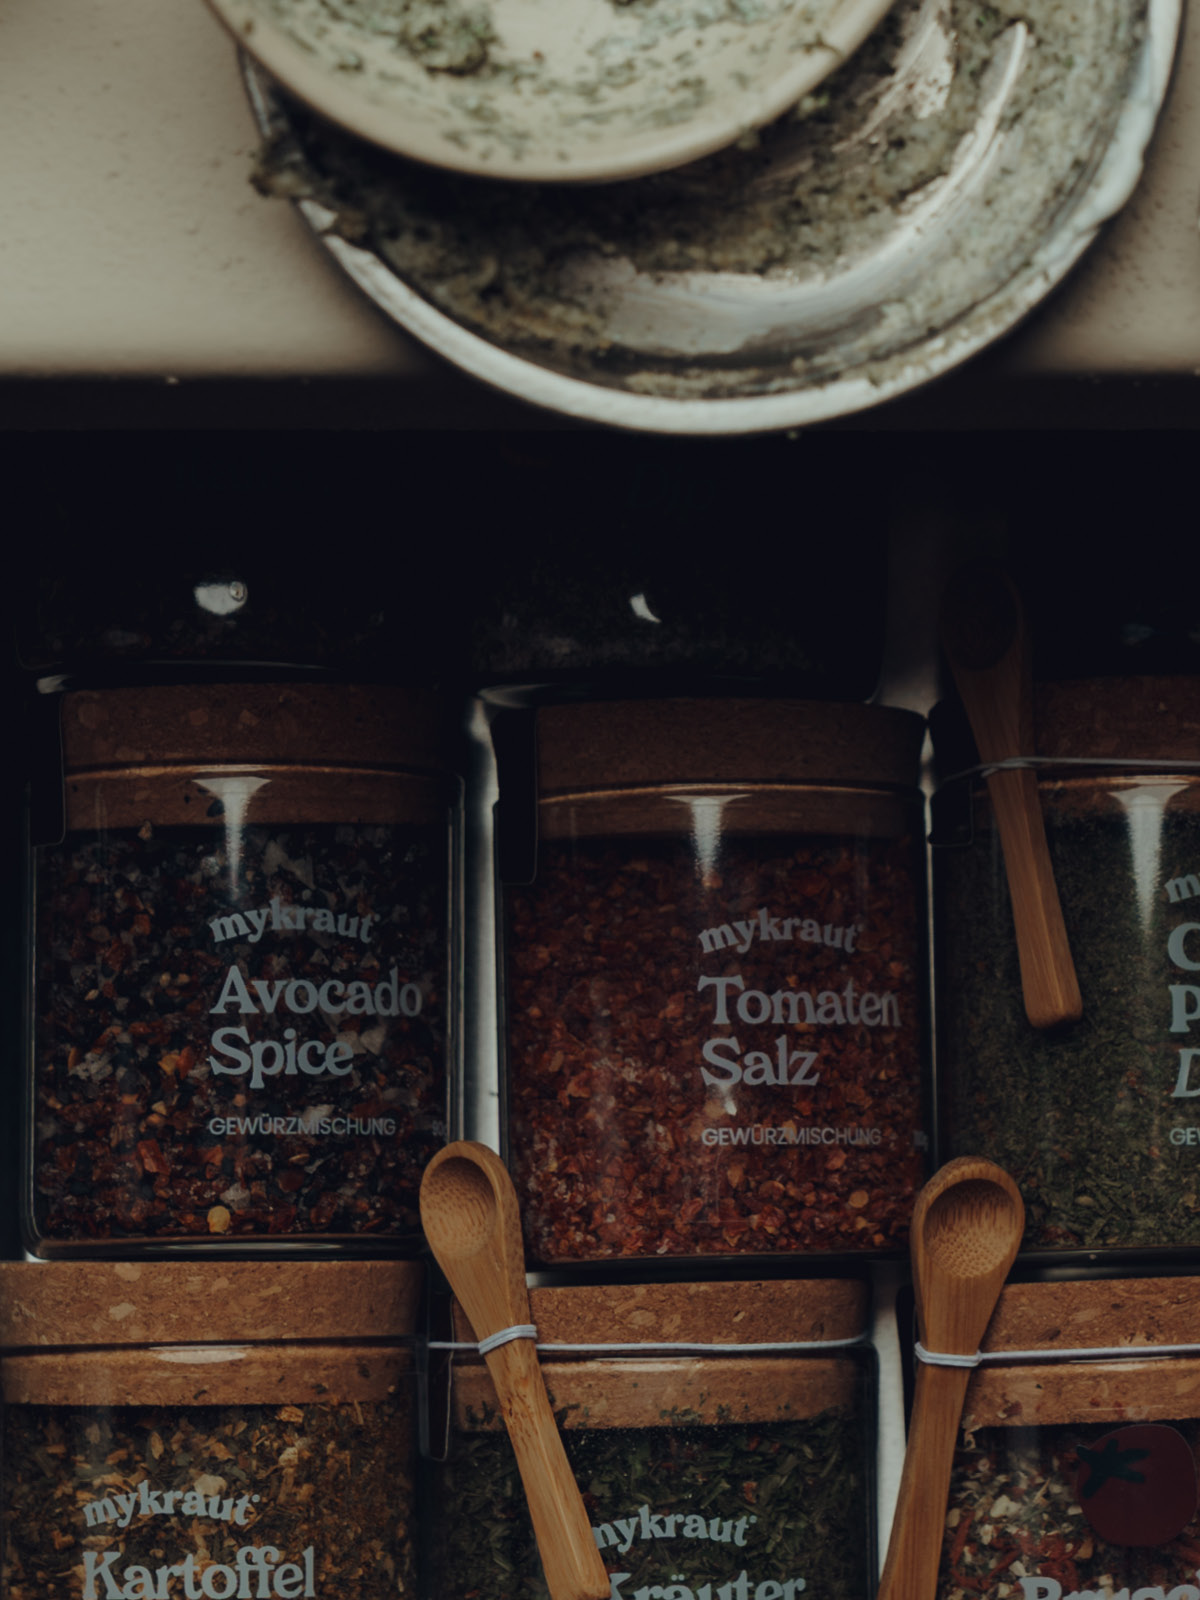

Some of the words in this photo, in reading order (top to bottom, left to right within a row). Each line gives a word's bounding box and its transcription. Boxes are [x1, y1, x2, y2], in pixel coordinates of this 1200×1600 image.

[208, 896, 375, 945] mykraut
[698, 907, 859, 955] mykraut
[209, 964, 424, 1018] Avocado
[697, 974, 903, 1028] Tomaten
[207, 1026, 355, 1090] Spice
[700, 1036, 821, 1088] Salz
[208, 1112, 397, 1137] GEWÜRZMISCHUNG
[701, 1123, 882, 1146] GEWÜRZMISCHUNG
[82, 1479, 250, 1528] mykraut
[82, 1545, 316, 1600] Kartoffel
